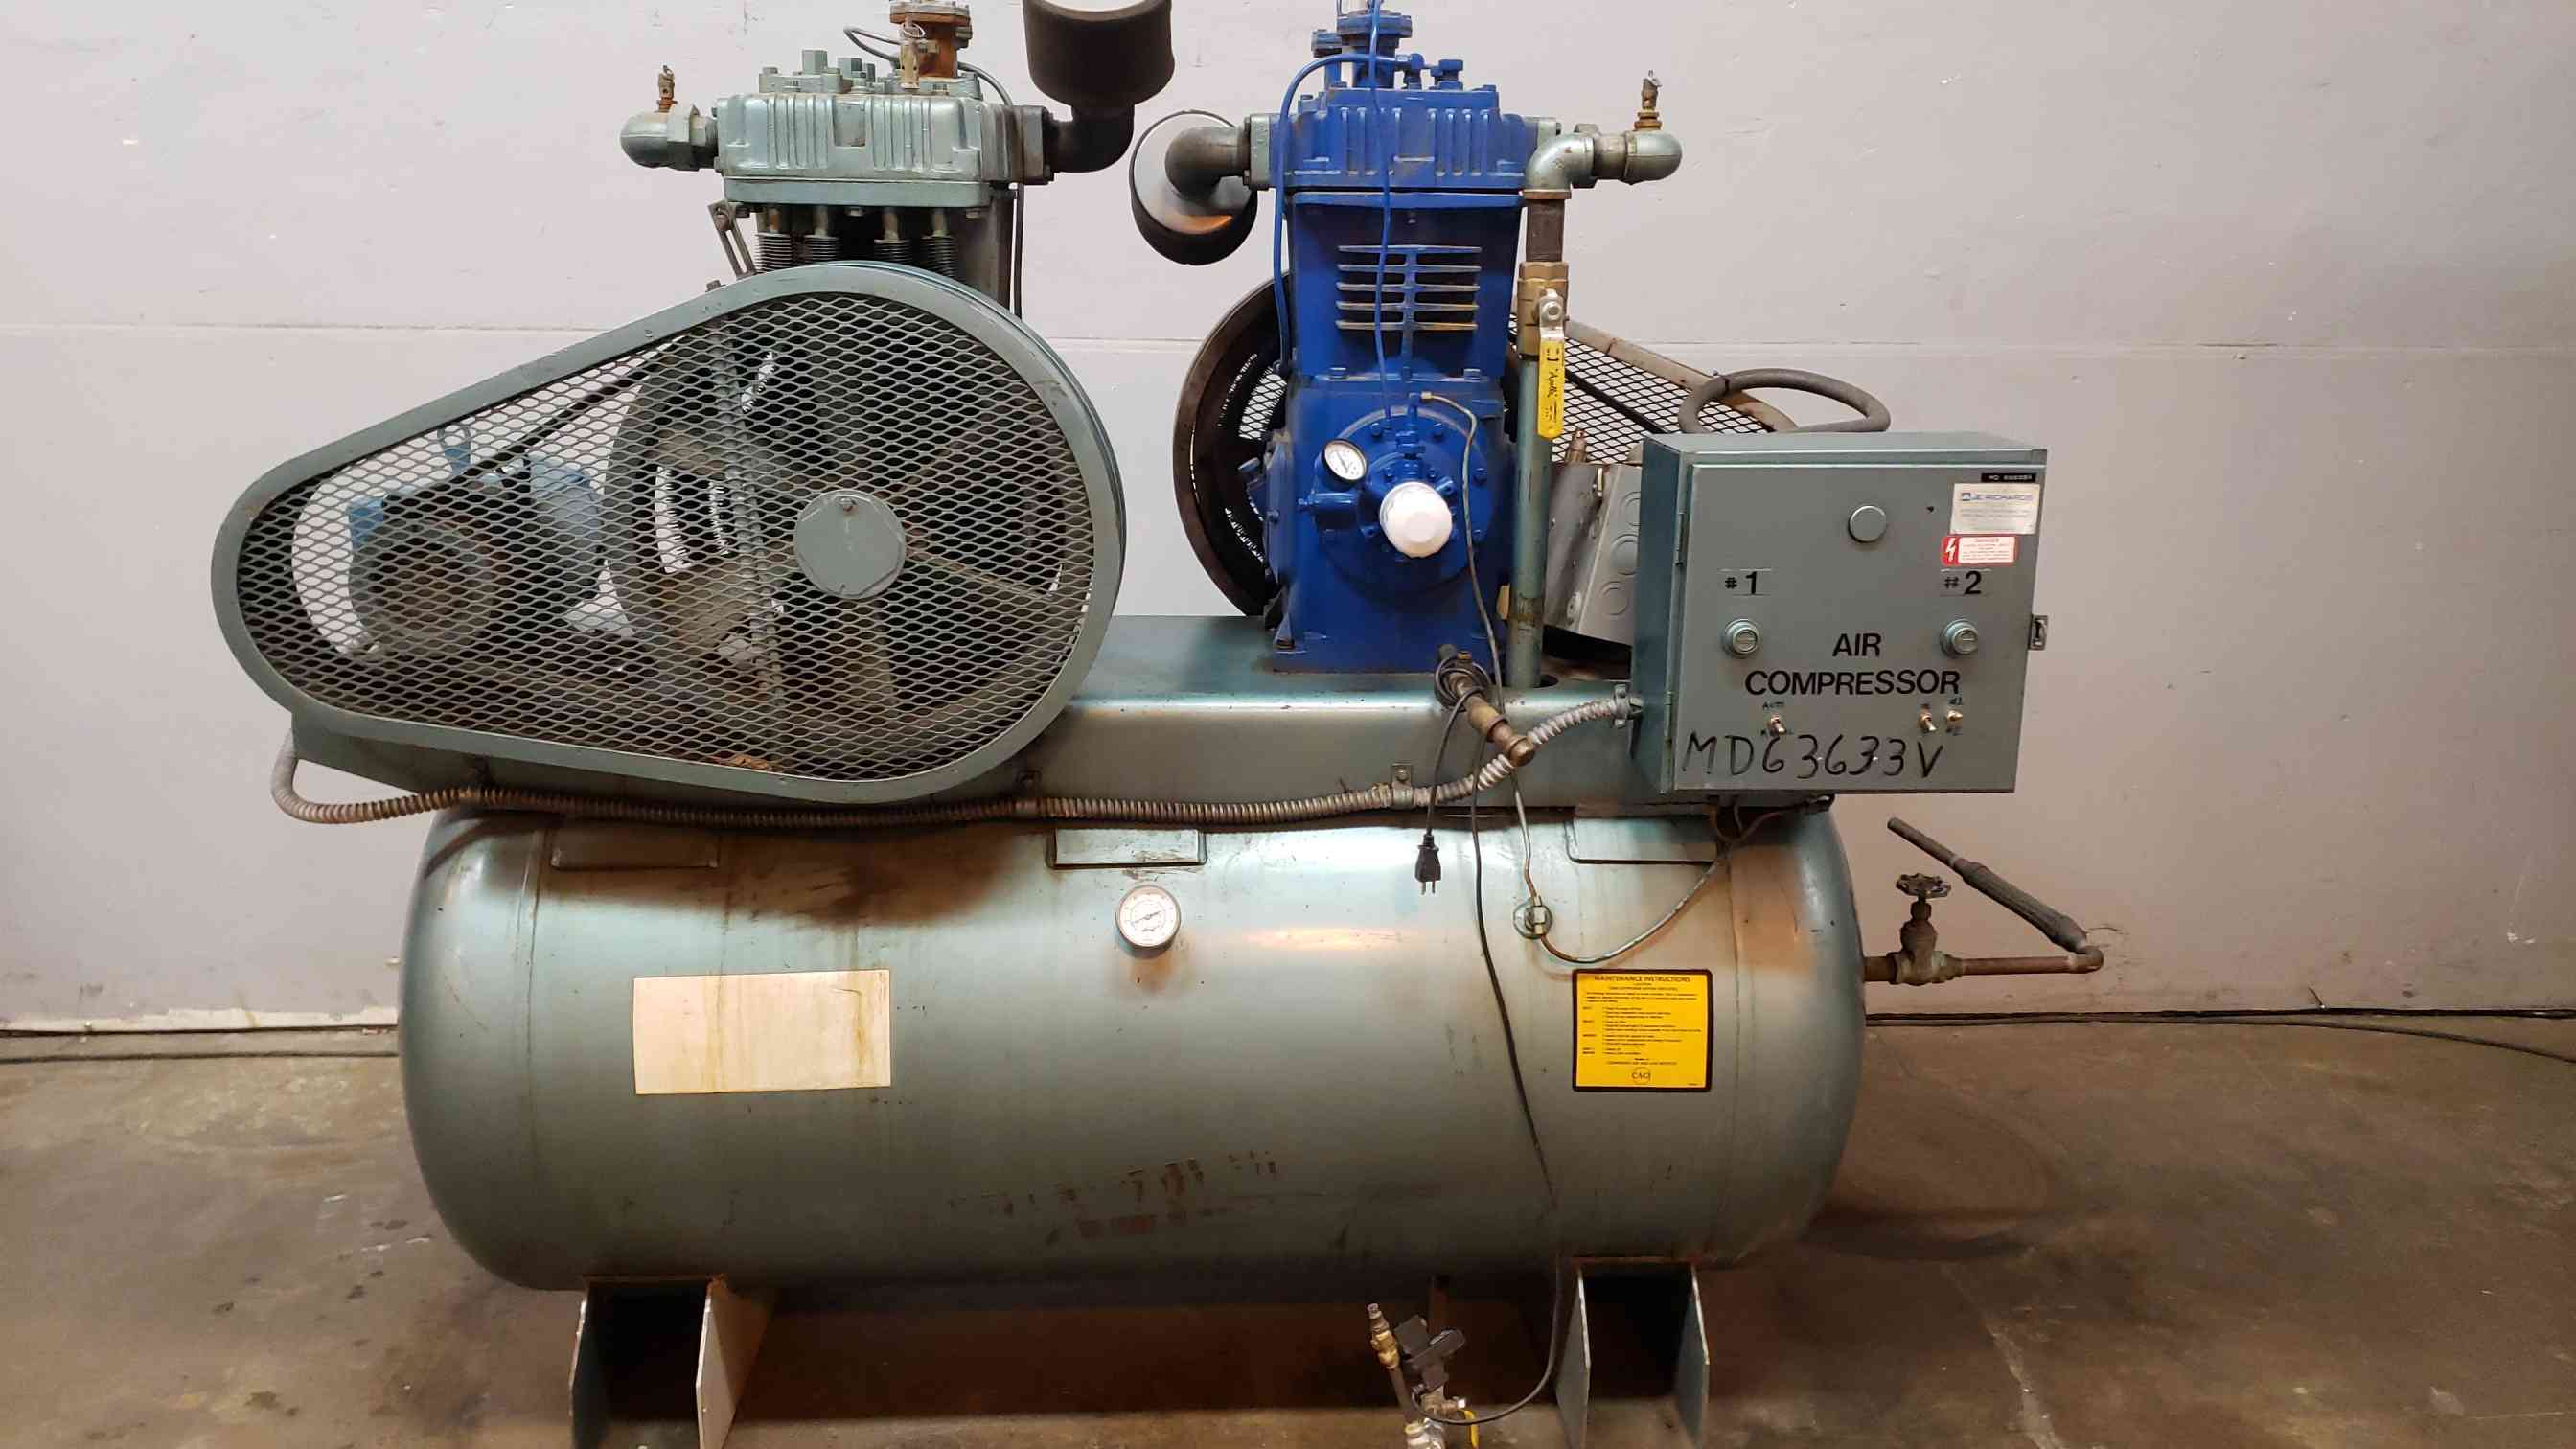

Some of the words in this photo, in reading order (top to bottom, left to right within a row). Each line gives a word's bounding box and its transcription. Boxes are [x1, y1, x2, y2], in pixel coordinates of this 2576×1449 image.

[1832, 632, 1881, 657] AIR
[1745, 670, 1960, 696] COMPRESSOR
[1682, 731, 1944, 779] MD63633V
